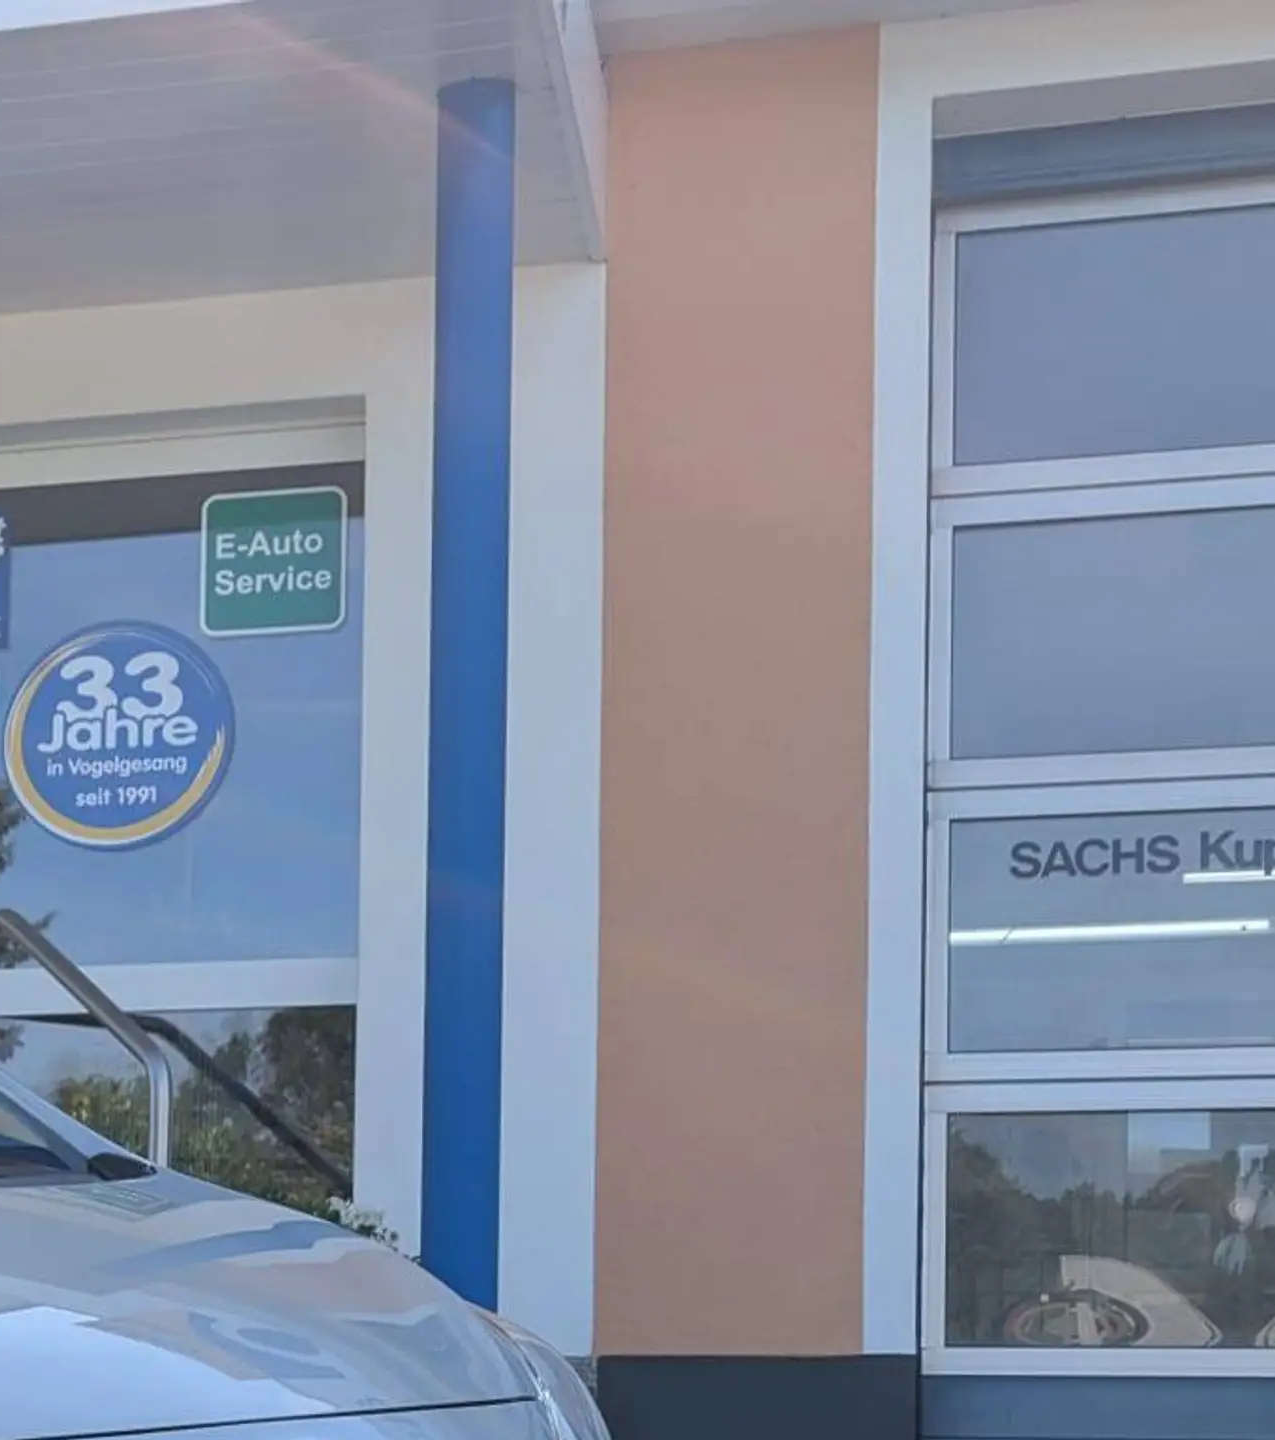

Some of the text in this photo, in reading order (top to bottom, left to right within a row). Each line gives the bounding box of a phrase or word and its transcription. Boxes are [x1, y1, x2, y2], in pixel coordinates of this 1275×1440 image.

[215, 529, 324, 560] E-Auto
[214, 565, 332, 596] Service
[56, 652, 184, 724] 33
[36, 707, 199, 753] Jahre
[47, 755, 188, 780] in Vogelgesang
[76, 784, 158, 807] seit 1991
[1009, 834, 1181, 879] SACHS
